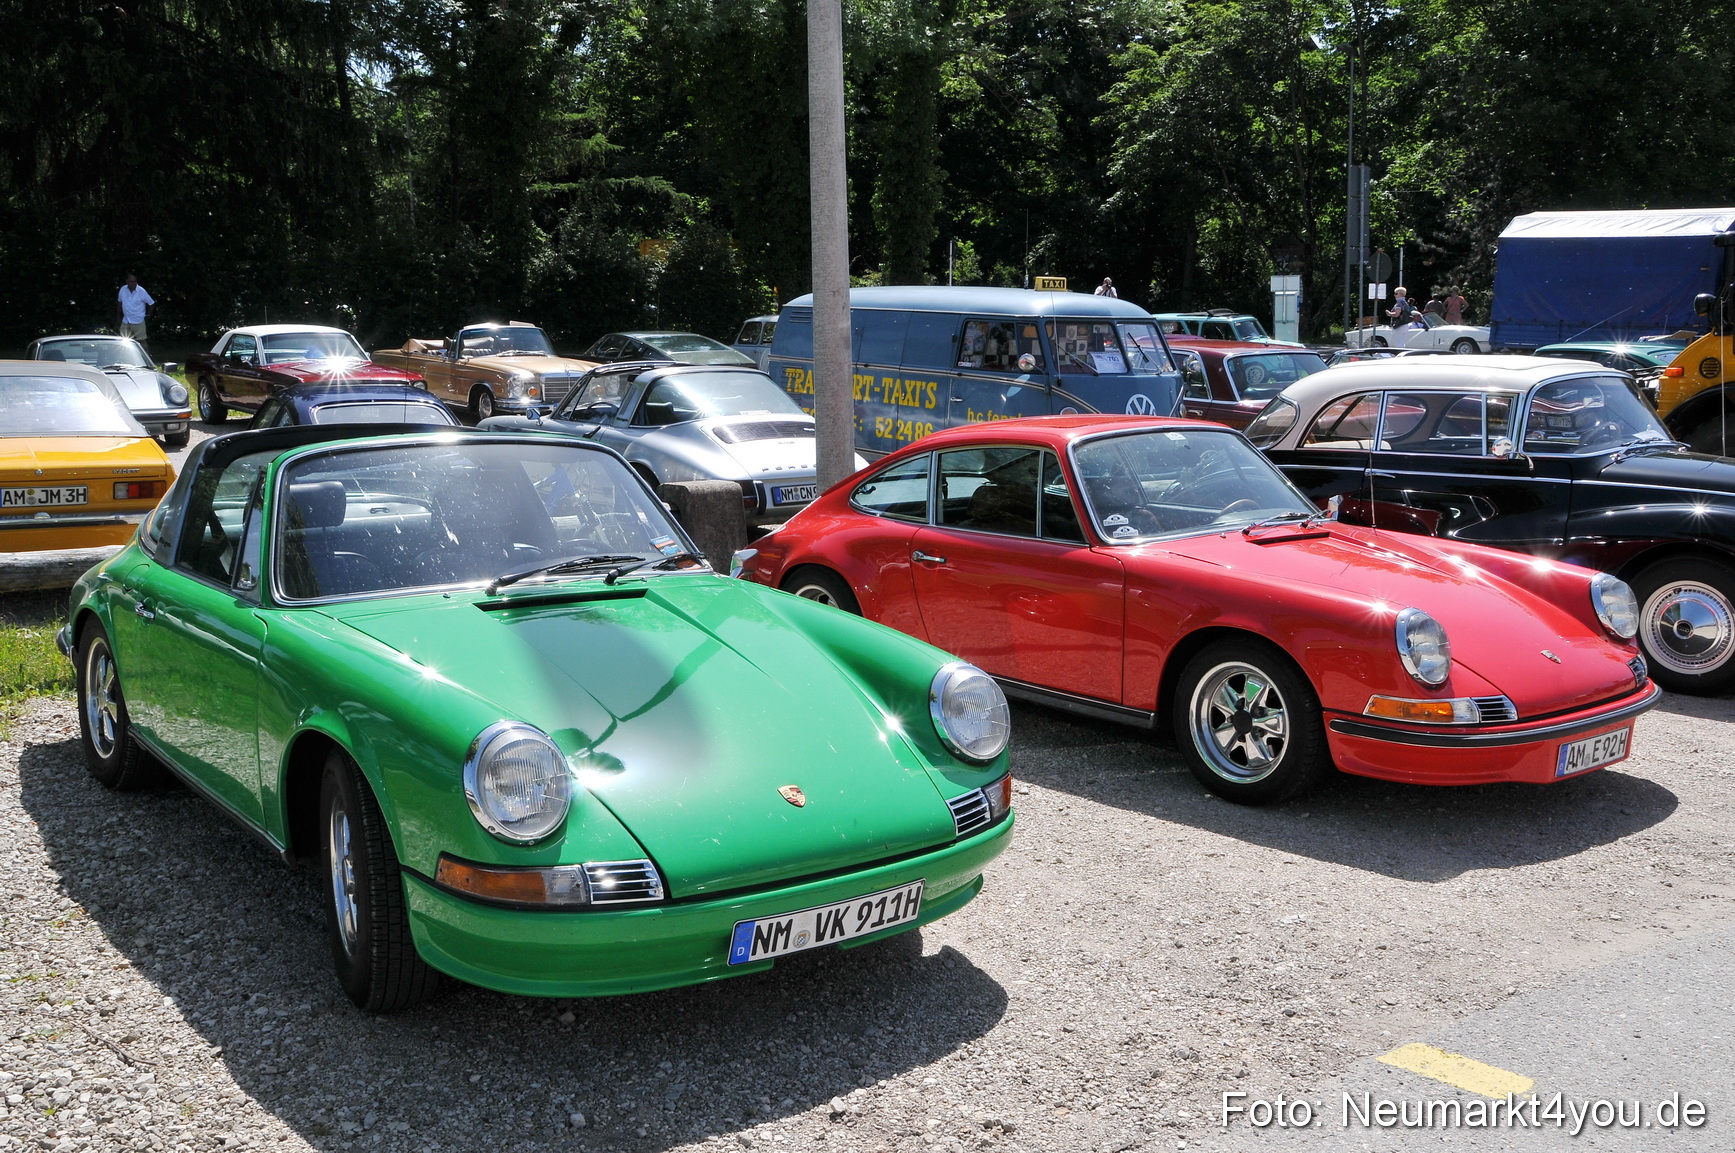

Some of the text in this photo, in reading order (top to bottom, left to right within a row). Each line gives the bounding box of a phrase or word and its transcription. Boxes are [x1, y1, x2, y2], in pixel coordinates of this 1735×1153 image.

[1043, 280, 1064, 288] TAXI
[785, 368, 938, 409] TRART-TAXI'S
[2, 488, 87, 505] AM JM 3H
[780, 488, 794, 501] NM
[1565, 743, 1587, 771] AM
[751, 886, 922, 956] NM VK 911H
